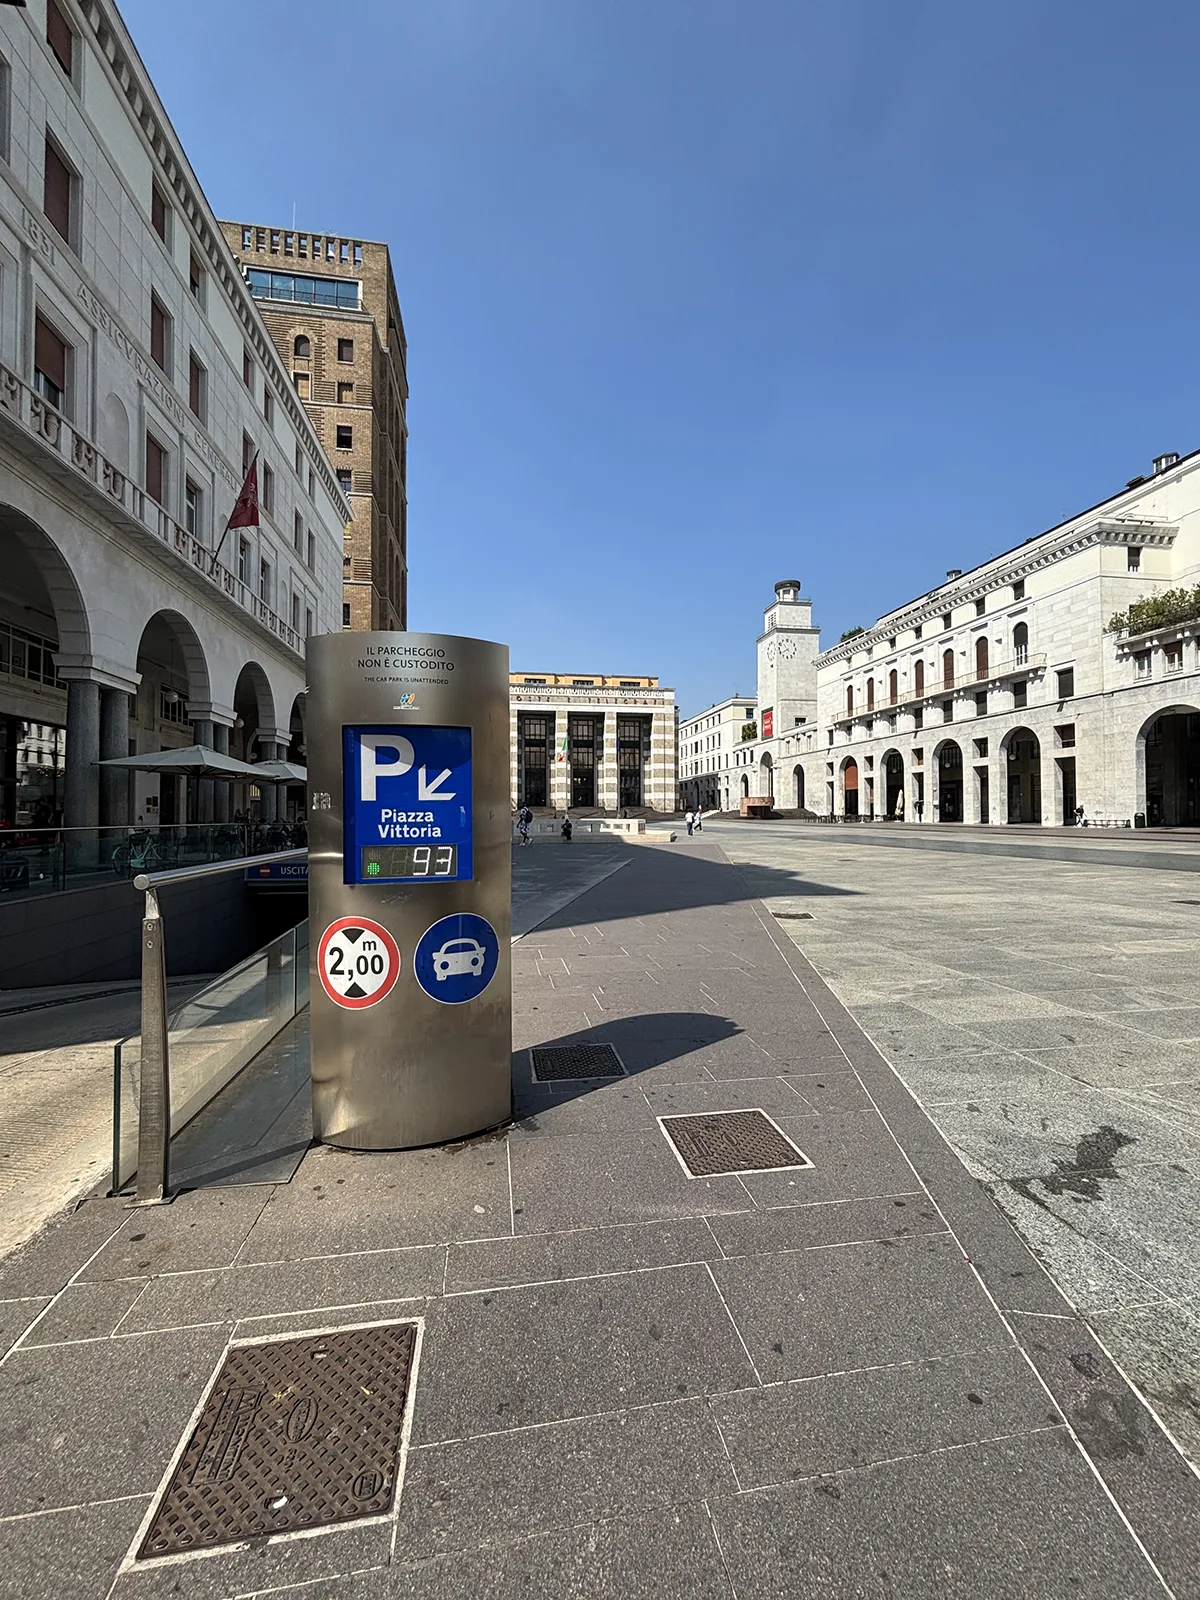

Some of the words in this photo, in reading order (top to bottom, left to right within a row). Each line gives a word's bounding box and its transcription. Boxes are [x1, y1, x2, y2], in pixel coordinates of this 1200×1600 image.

[76, 283, 185, 428] ASSICVRAZIONI
[366, 646, 375, 655] IL
[377, 646, 446, 658] PARCHEGGIO
[357, 659, 381, 668] NON
[384, 657, 390, 668] È
[392, 659, 455, 671] CUSTODITO
[410, 677, 449, 685] UNATTENDED
[360, 734, 415, 801] P
[381, 808, 434, 823] Piazza
[378, 824, 442, 839] Vittoria
[413, 846, 453, 876] 93
[362, 940, 377, 951] m
[329, 946, 384, 981] 2,00
